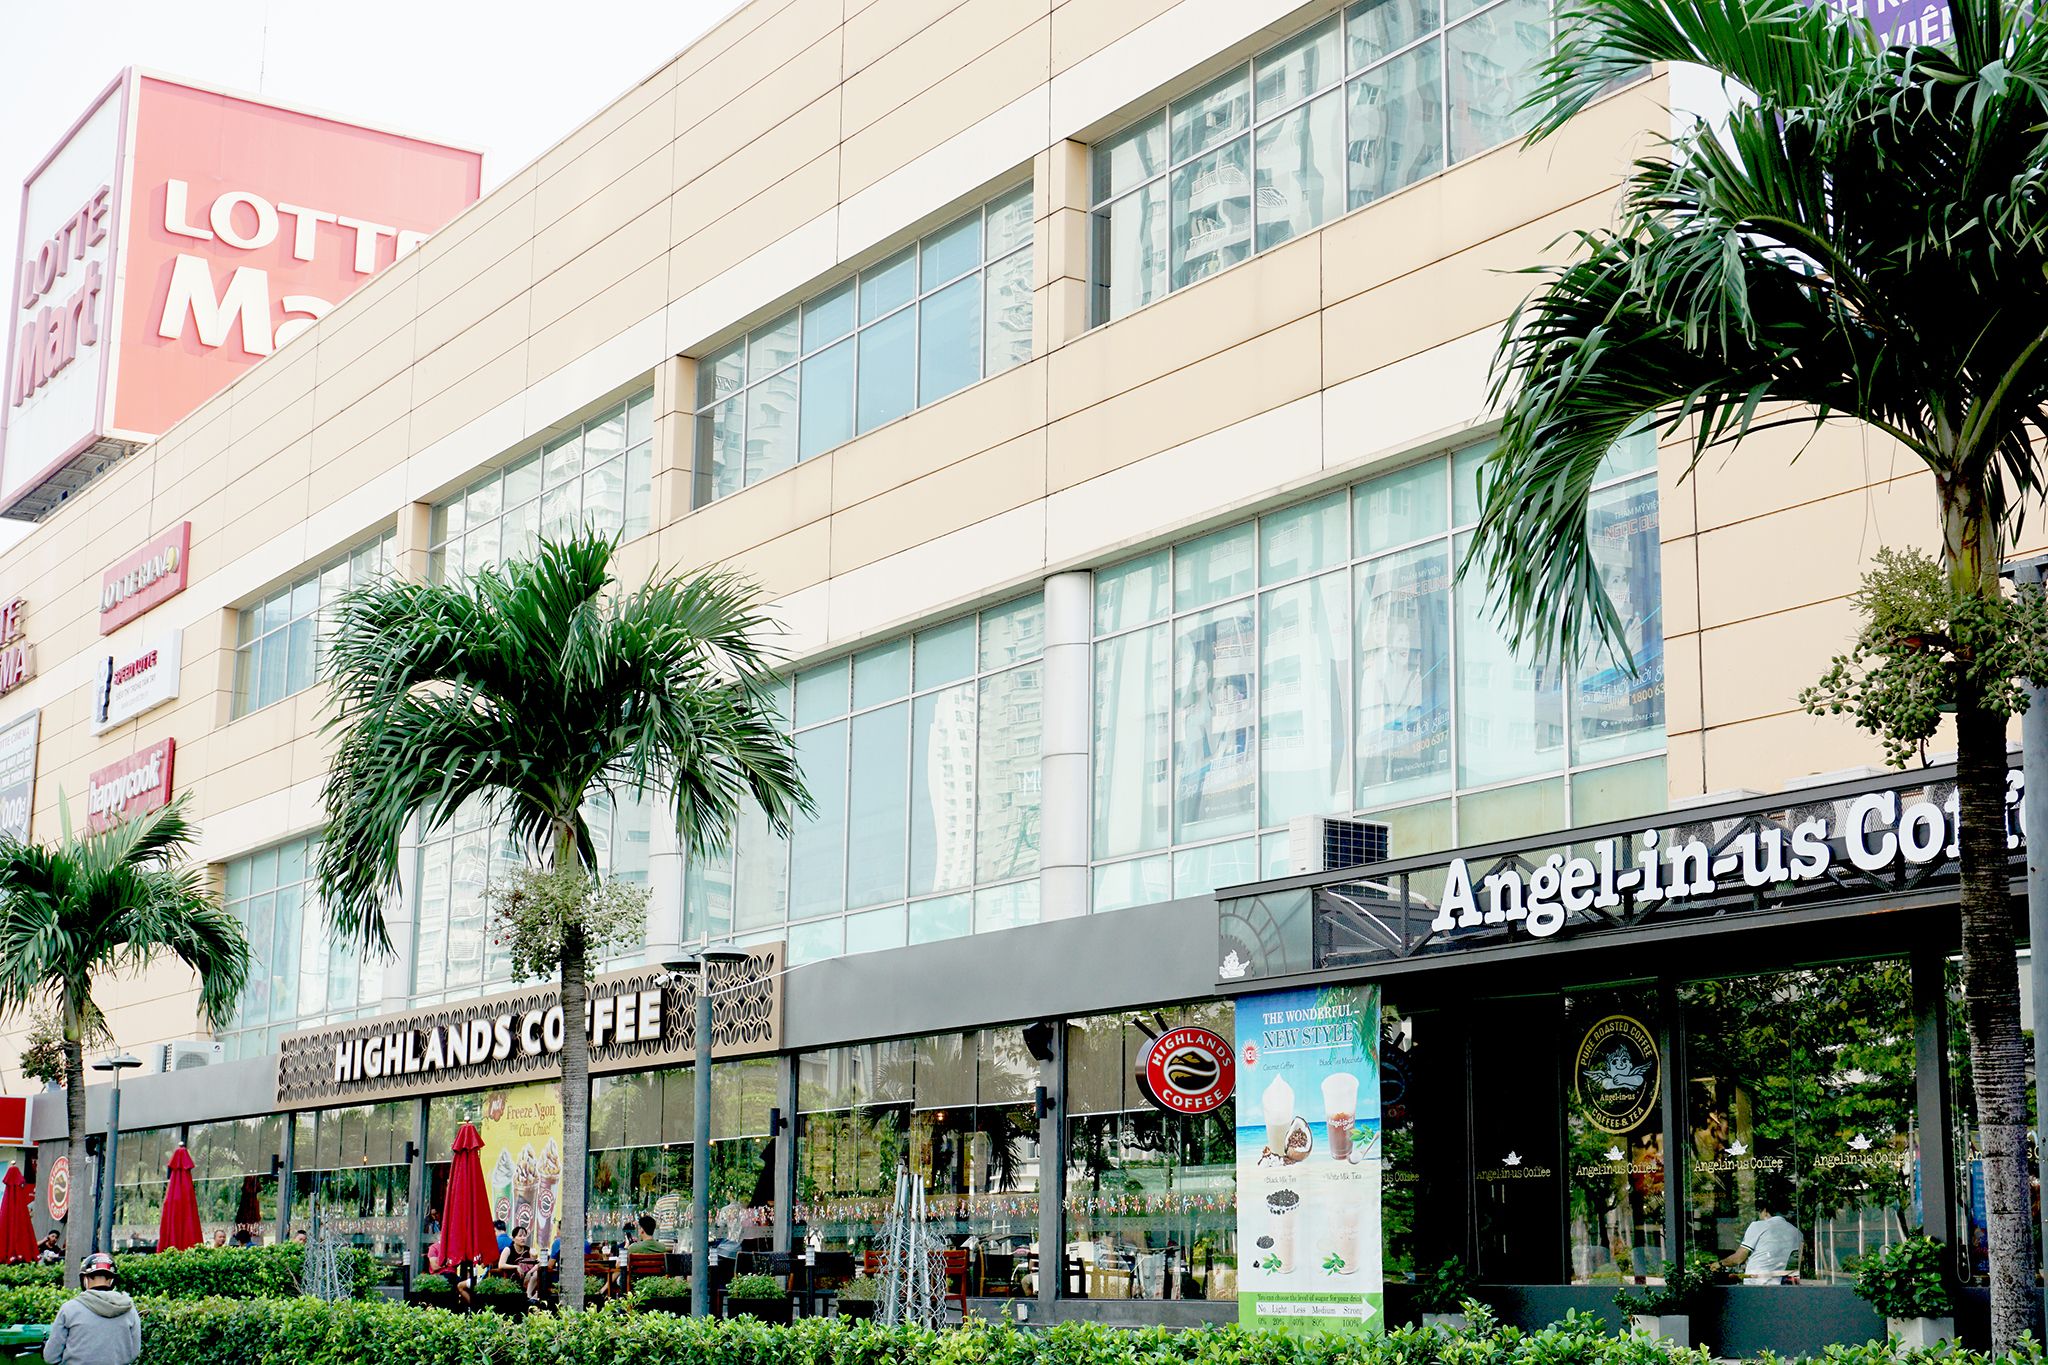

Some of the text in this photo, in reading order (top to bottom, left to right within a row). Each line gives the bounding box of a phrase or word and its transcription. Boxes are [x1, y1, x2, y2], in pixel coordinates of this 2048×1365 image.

[22, 185, 110, 309] LOTTE
[13, 261, 101, 407] Mart
[1631, 686, 1653, 706] 1800
[1432, 817, 1831, 937] Angel-in-us
[1263, 1004, 1353, 1025] THE WONDERFUL
[1263, 1022, 1353, 1049] NEW STYLE
[1580, 1021, 1653, 1066] PURE ROASTED COFFEE
[334, 1013, 512, 1084] HIGHLANDS
[1151, 1033, 1232, 1067] HIGHLANDS
[1162, 1088, 1224, 1109] COFFEE
[1600, 1092, 1636, 1104] Angel-in-us
[507, 1102, 557, 1121] Freeze Ngon
[1591, 1107, 1645, 1128] COFFEE & TEA
[1576, 1162, 1657, 1178] Angel-in-us Coffee
[1693, 1155, 1784, 1174] Angel-in-us Coffee
[1813, 1152, 1873, 1168] Angel-in-us
[1476, 1165, 1551, 1181] Angel-in-us Coffee
[1258, 1304, 1266, 1312] No
[1271, 1304, 1287, 1314] Light
[1293, 1305, 1306, 1313] Less
[1312, 1306, 1336, 1314] Medium
